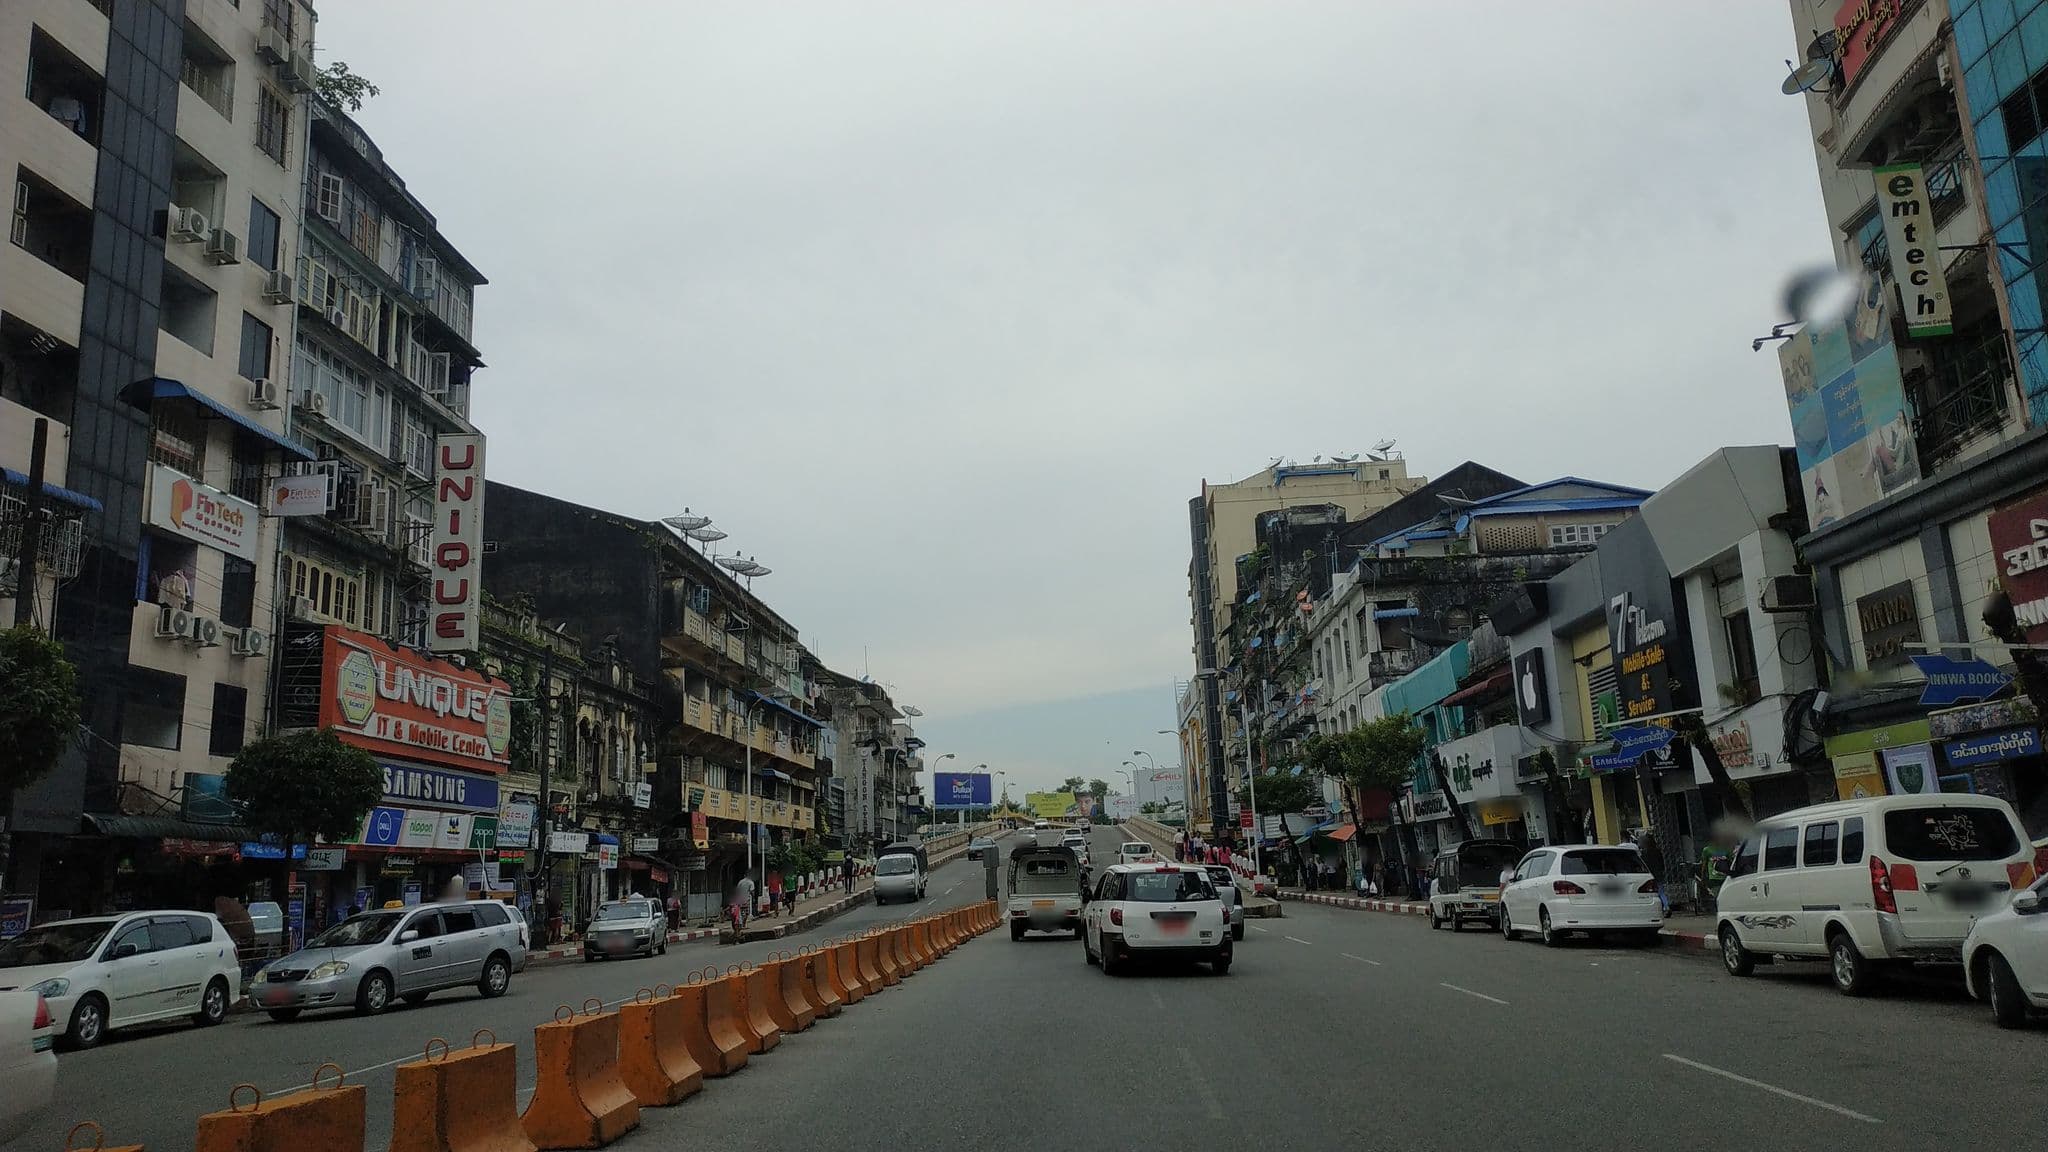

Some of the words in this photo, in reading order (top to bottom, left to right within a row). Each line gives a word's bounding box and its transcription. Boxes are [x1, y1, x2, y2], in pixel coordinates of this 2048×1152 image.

[1888, 174, 1936, 315] emtech
[291, 487, 321, 496] FinTech
[195, 512, 243, 537] Myanmar
[197, 492, 243, 528] FinTech
[437, 444, 474, 638] UNIQUE
[1622, 653, 1647, 675] Mobile
[1930, 672, 1967, 686] INNWA
[1968, 671, 2007, 685] BOOKS
[377, 660, 488, 723] UNIQUE
[1627, 695, 1656, 718] Service
[377, 715, 390, 736] IT
[394, 720, 403, 739] &
[408, 723, 449, 749] Mobile
[452, 733, 487, 757] Center
[382, 766, 466, 803] SAMSUNG
[474, 828, 493, 836] oppo
